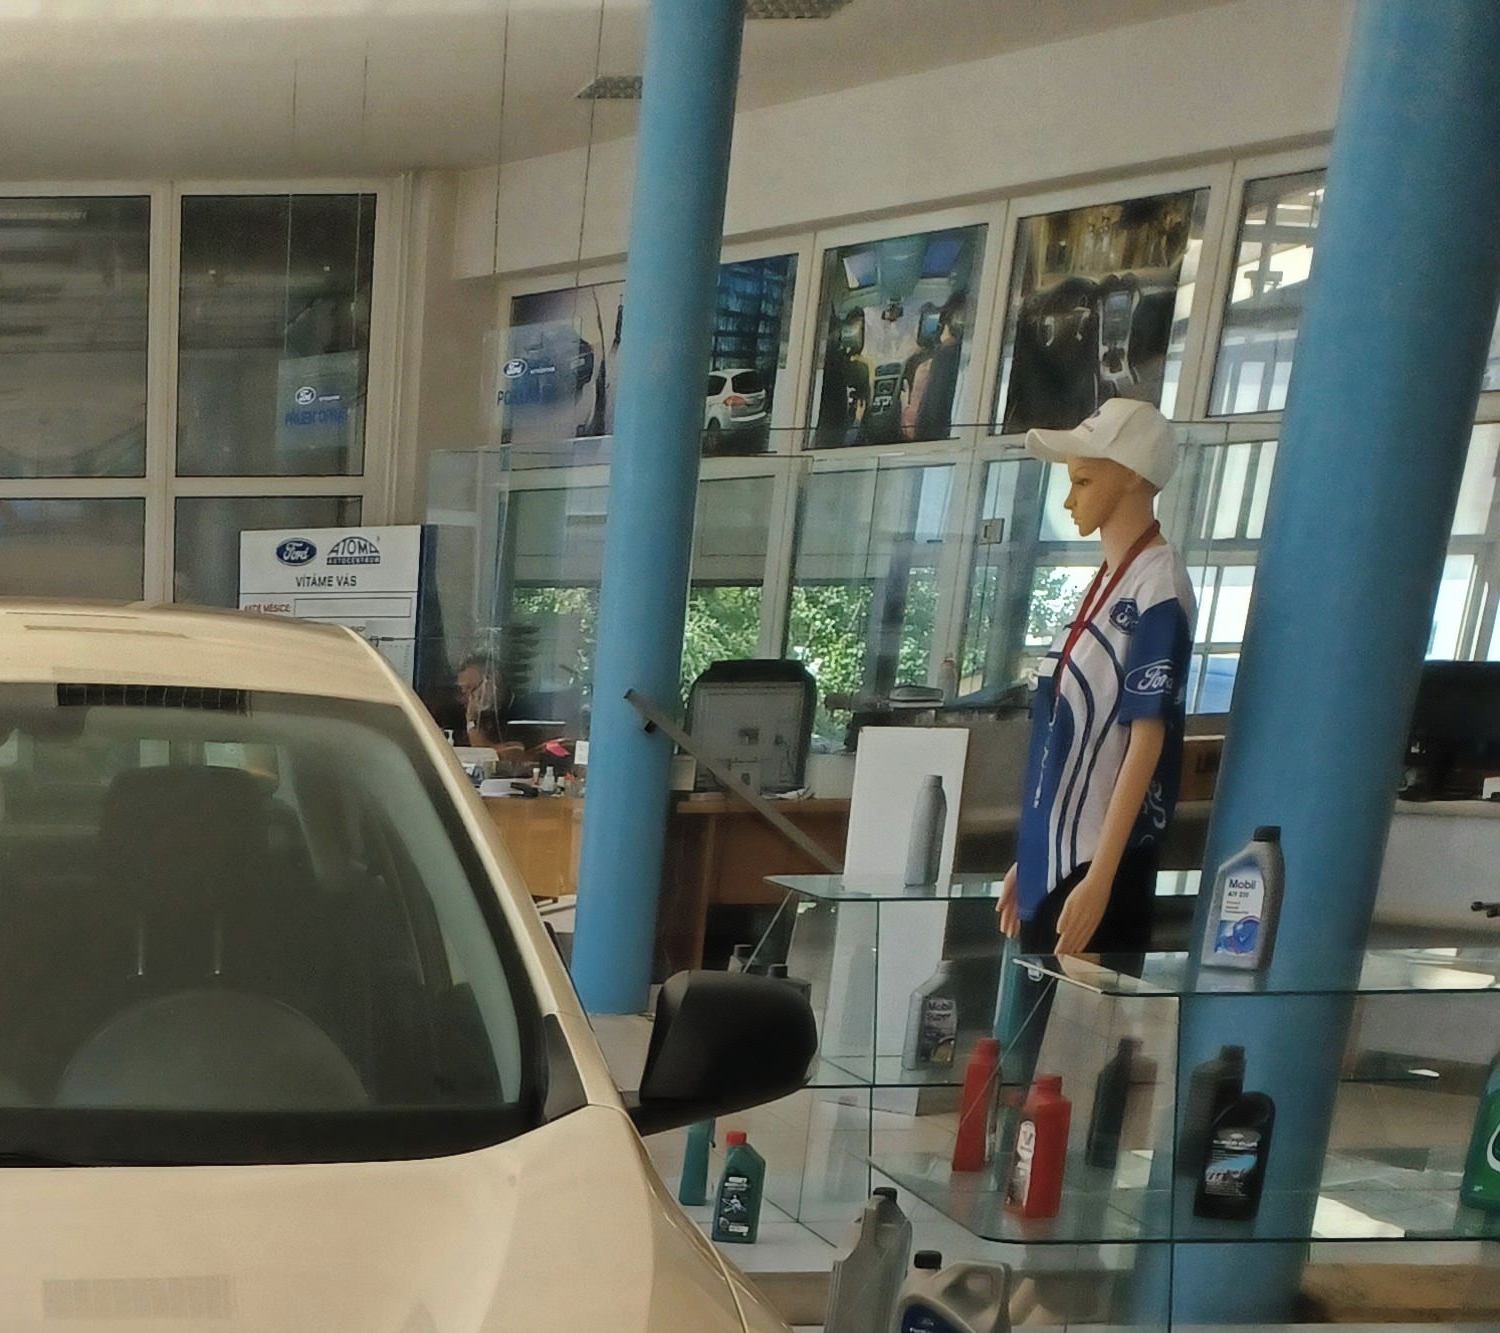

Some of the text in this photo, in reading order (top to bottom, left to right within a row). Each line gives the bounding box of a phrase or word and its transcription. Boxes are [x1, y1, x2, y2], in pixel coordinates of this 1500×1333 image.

[295, 572, 357, 587] VÍTÁME VÁS
[1228, 879, 1256, 890] Mobil
